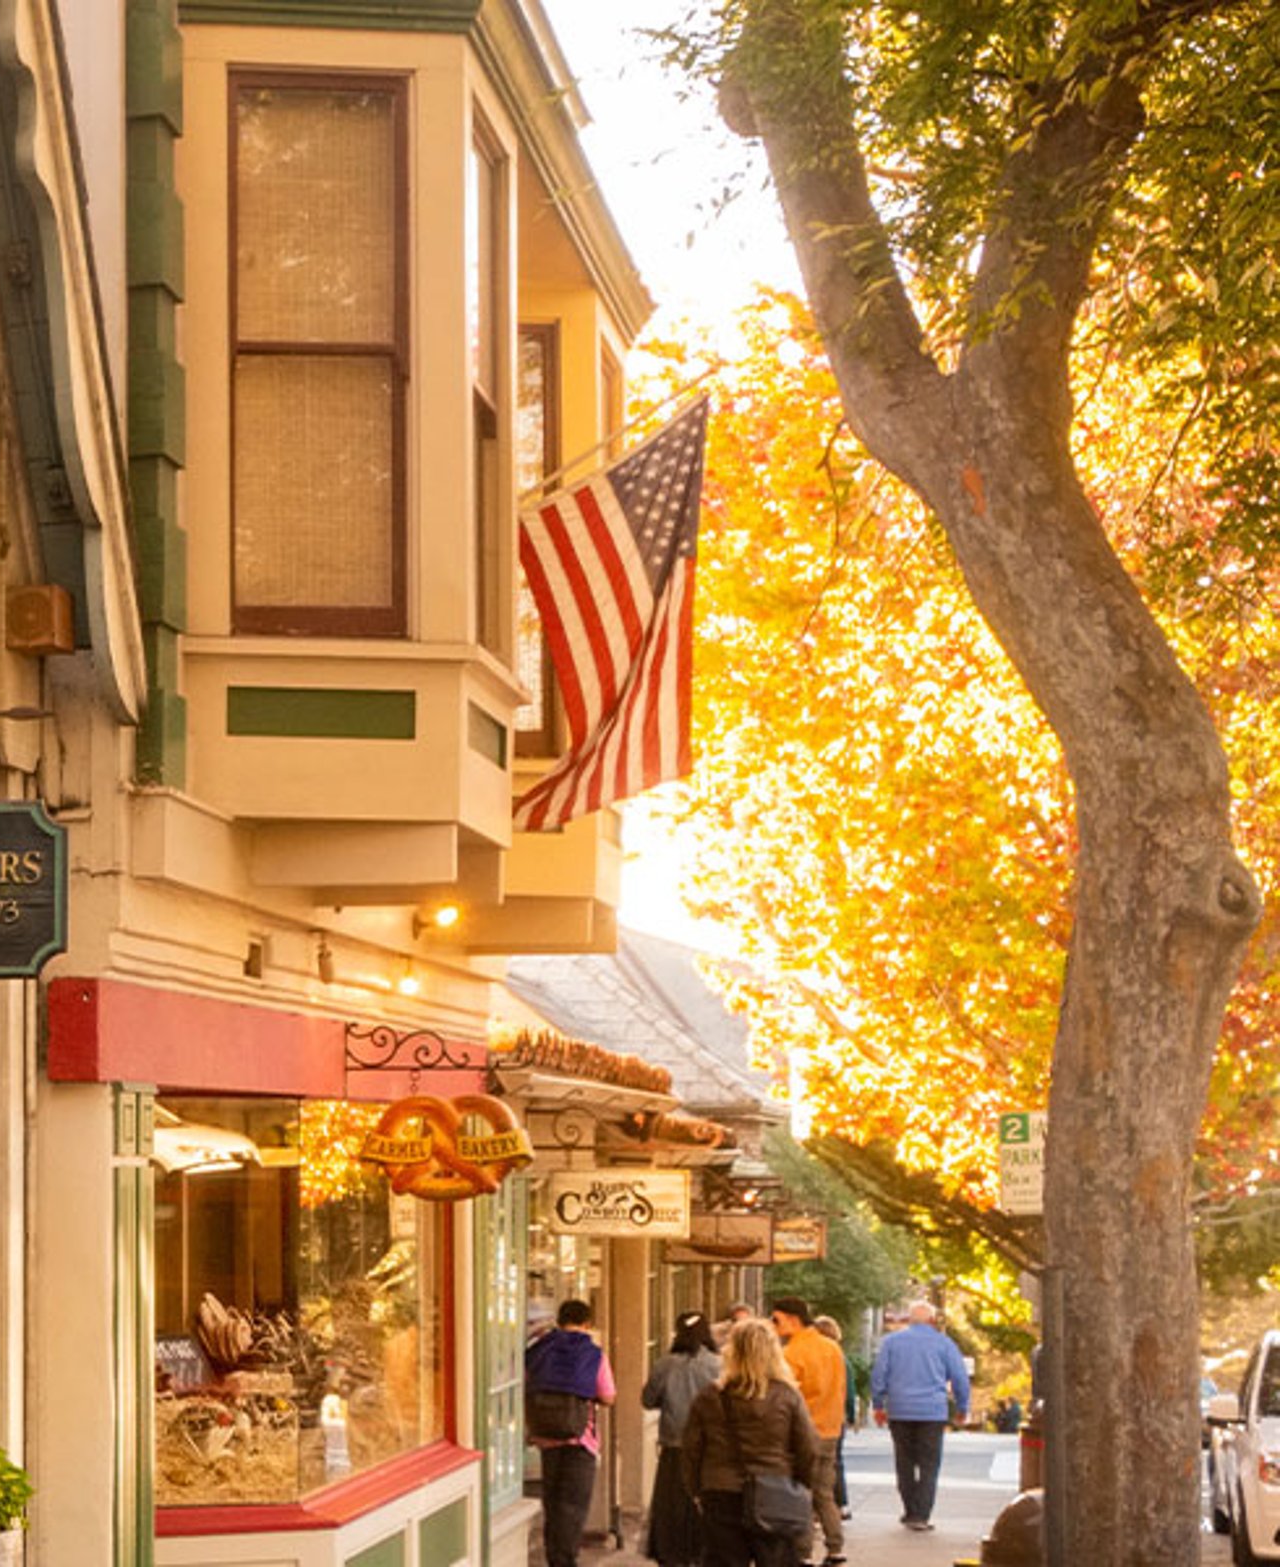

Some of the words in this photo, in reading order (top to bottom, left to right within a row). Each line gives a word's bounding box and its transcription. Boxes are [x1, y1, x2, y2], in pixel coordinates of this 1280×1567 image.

[1006, 1118, 1022, 1139] 2
[364, 1134, 427, 1158] CARMEL
[460, 1133, 519, 1156] BAKERY
